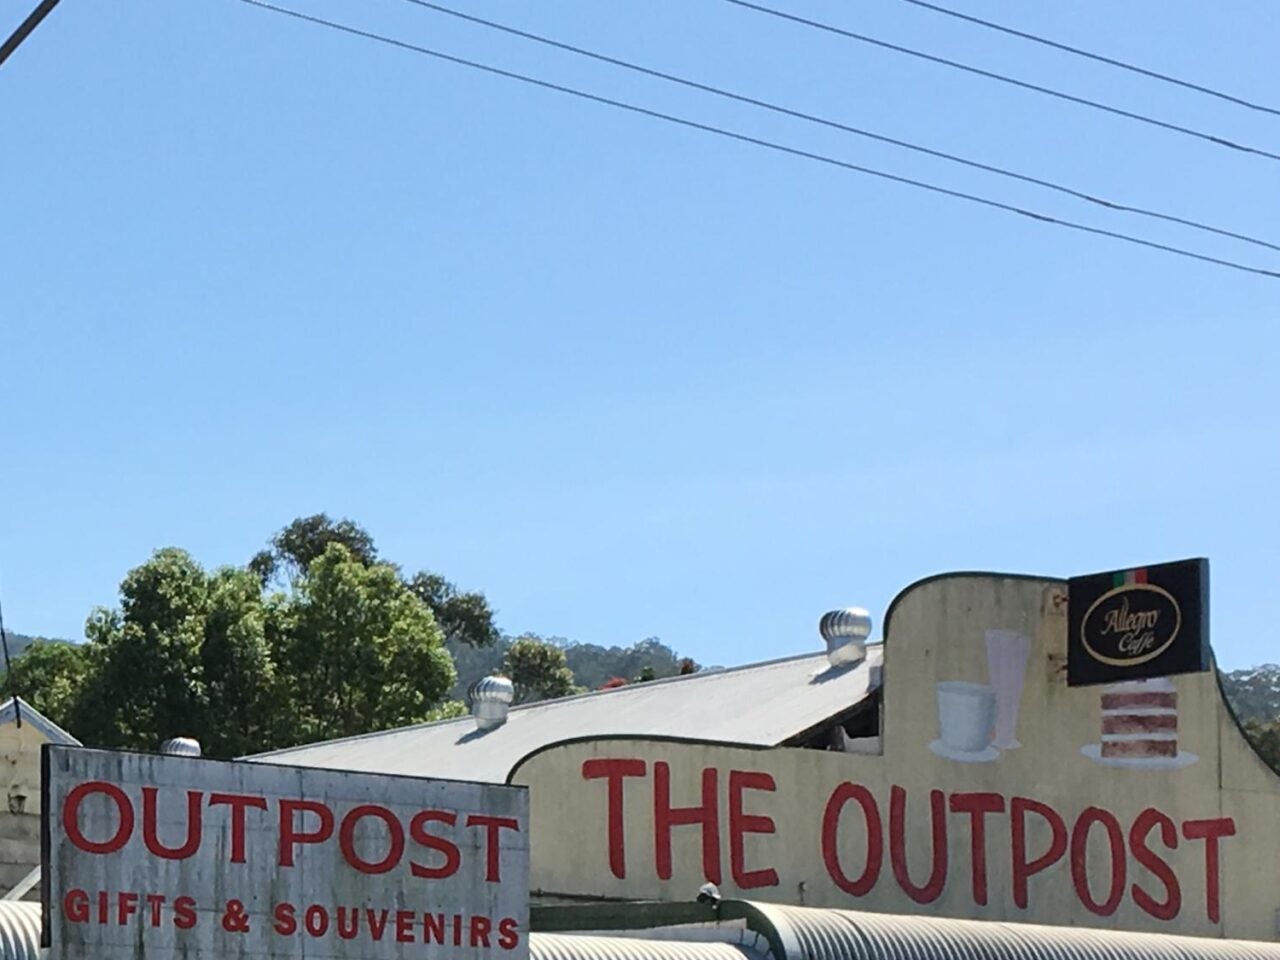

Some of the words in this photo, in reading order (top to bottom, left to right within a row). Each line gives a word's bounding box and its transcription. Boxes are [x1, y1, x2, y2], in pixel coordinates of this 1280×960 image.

[1101, 595, 1160, 635] Allegro
[62, 781, 520, 883] OUTPOST
[582, 758, 781, 889] THE
[820, 781, 1237, 923] OUTPOST
[64, 889, 198, 929] GIFTS
[222, 899, 250, 933] &
[274, 903, 519, 950] SOUVENIRS
